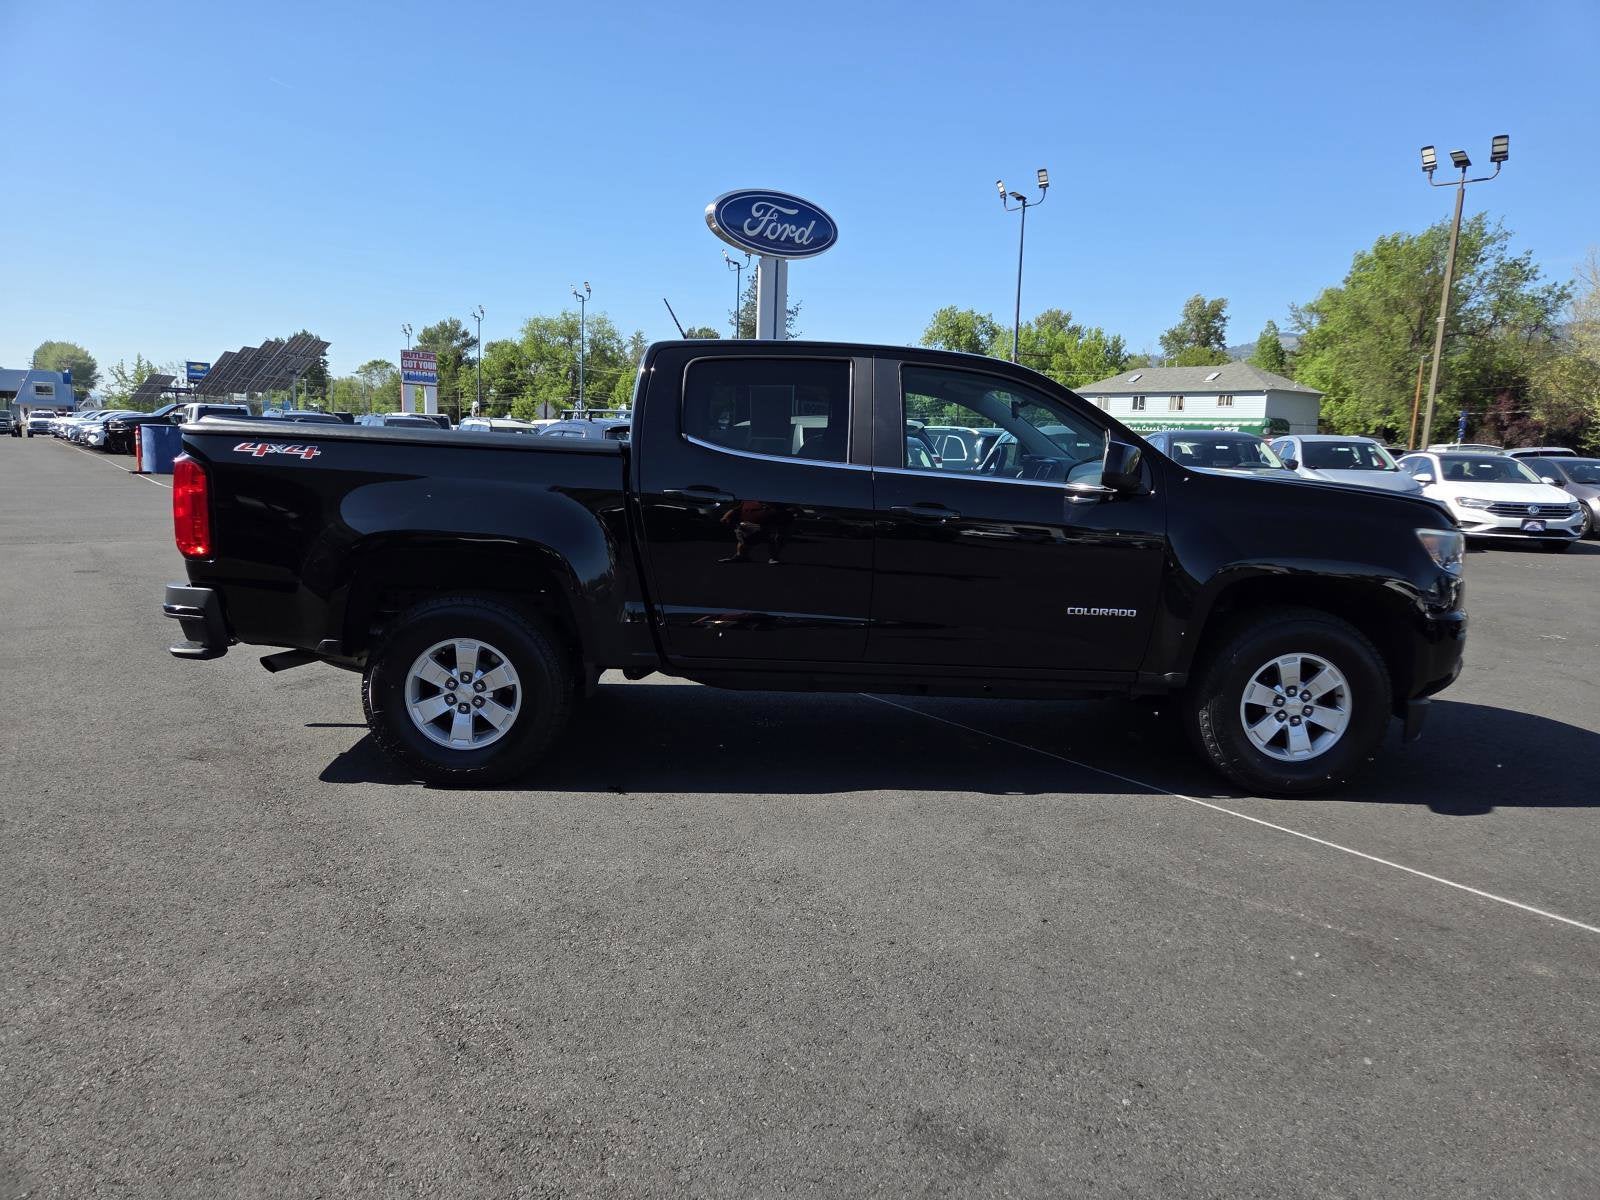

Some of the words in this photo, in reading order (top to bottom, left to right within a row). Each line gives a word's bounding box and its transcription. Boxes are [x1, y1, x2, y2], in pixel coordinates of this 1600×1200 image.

[743, 201, 816, 245] Ford
[418, 361, 436, 371] YOUR
[1067, 607, 1137, 617] COLORADO
